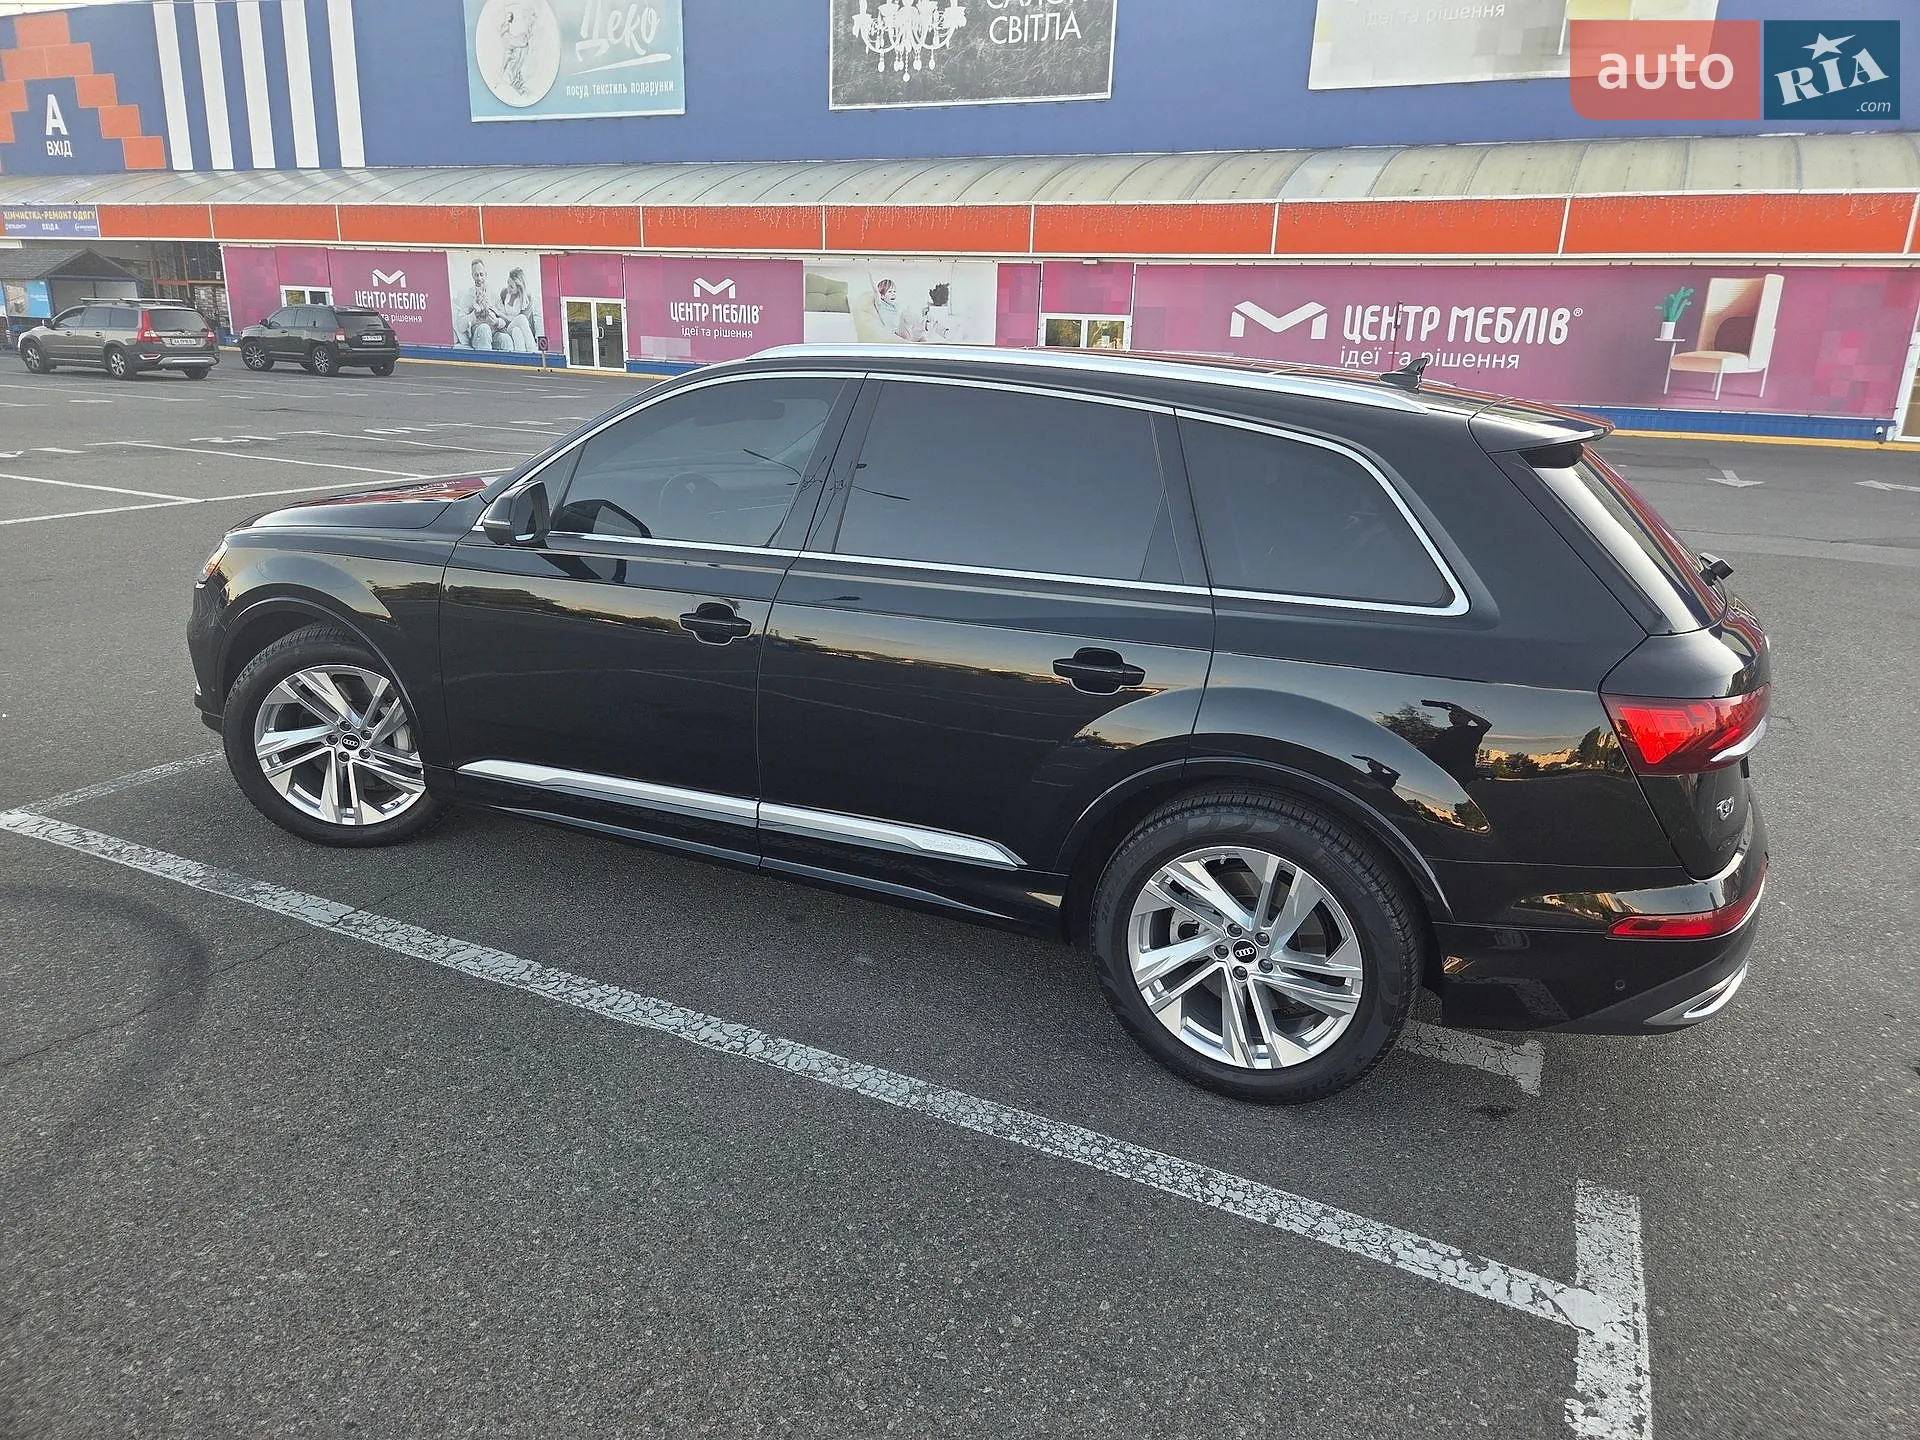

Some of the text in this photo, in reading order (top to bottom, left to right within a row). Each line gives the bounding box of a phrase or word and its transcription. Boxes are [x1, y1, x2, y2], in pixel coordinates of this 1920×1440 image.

[1425, 3, 1506, 26] рішення
[989, 10, 1082, 45] СВІТЛА
[566, 79, 674, 99] посуд текстиль подарунки
[46, 140, 73, 158] ВХІД
[355, 290, 386, 308] ЦЕНТР
[391, 313, 422, 324] рішення
[670, 301, 709, 322] ЦЕНТР
[681, 325, 753, 340] ідеї та рішення
[1343, 304, 1441, 344] ЦЕНТР
[1340, 345, 1382, 368] ідеї
